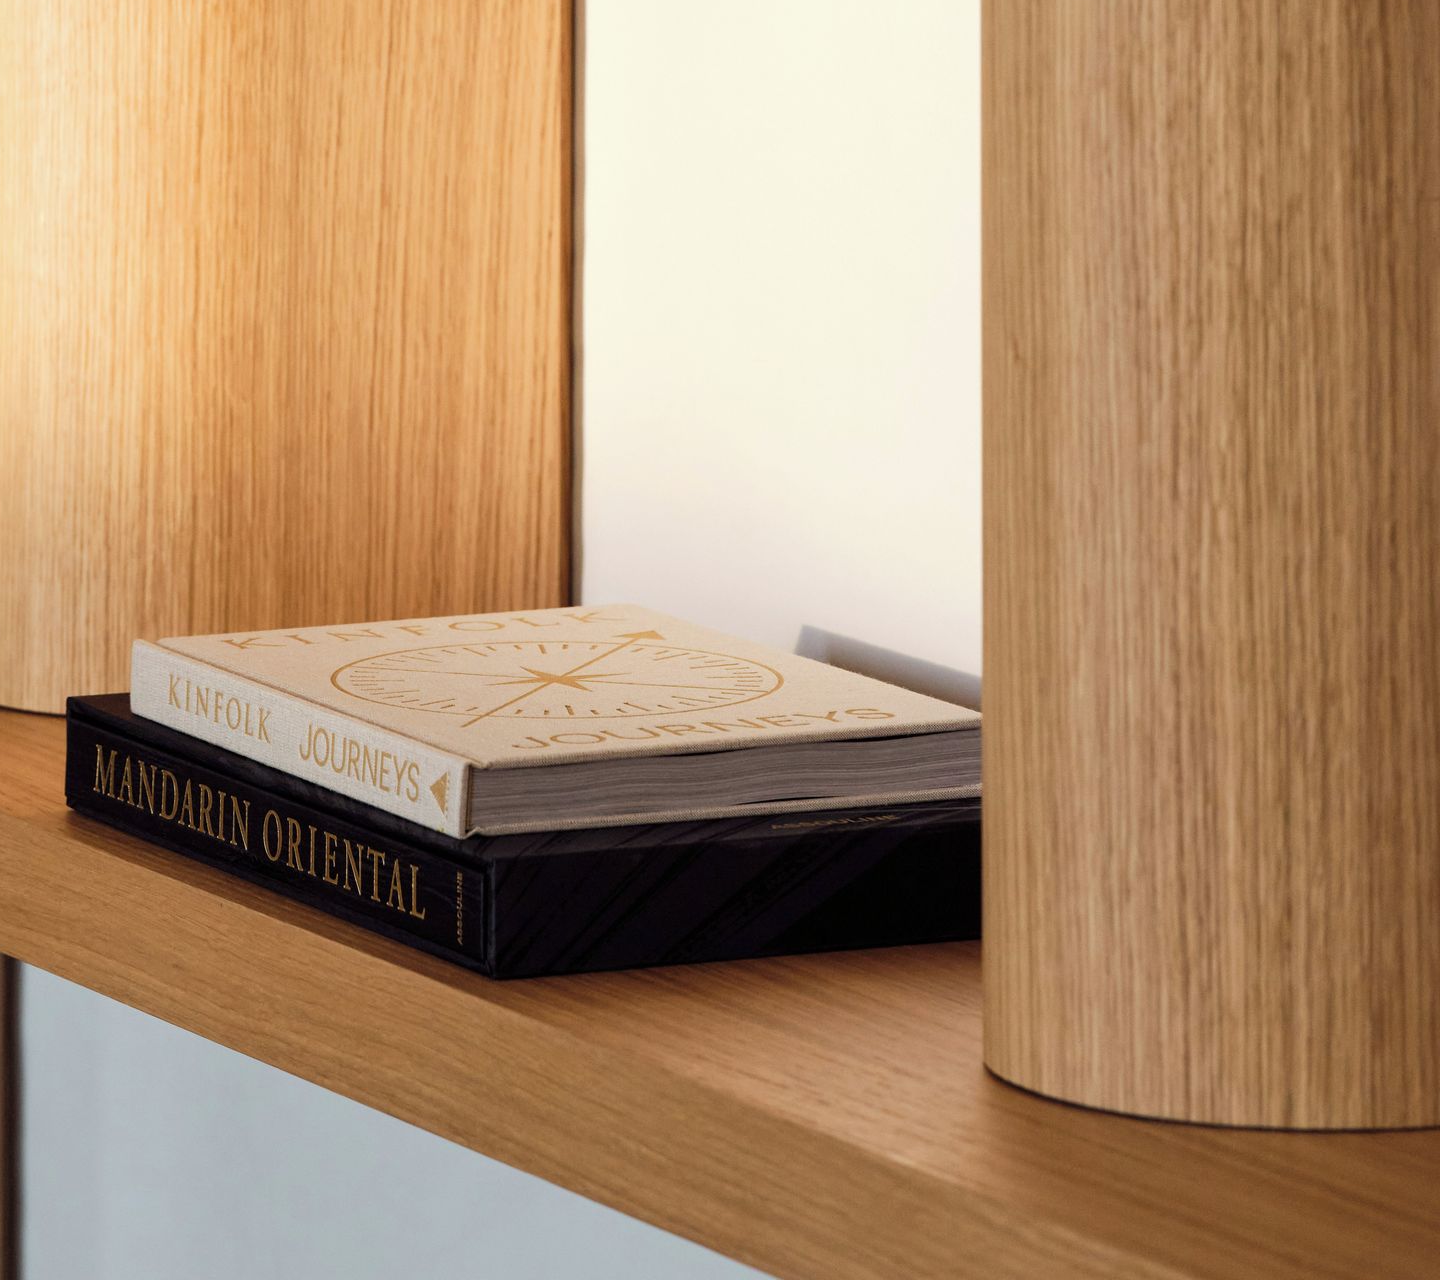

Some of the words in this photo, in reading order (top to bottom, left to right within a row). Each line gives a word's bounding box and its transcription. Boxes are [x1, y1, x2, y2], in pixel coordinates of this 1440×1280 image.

[221, 610, 629, 651] KINFOLK
[167, 673, 271, 744] KINFOLK
[299, 721, 420, 804] JOURNEYS
[511, 707, 896, 750] JOURNEYS
[92, 743, 251, 852] MANDARIN
[262, 809, 427, 921] ORIENTAL
